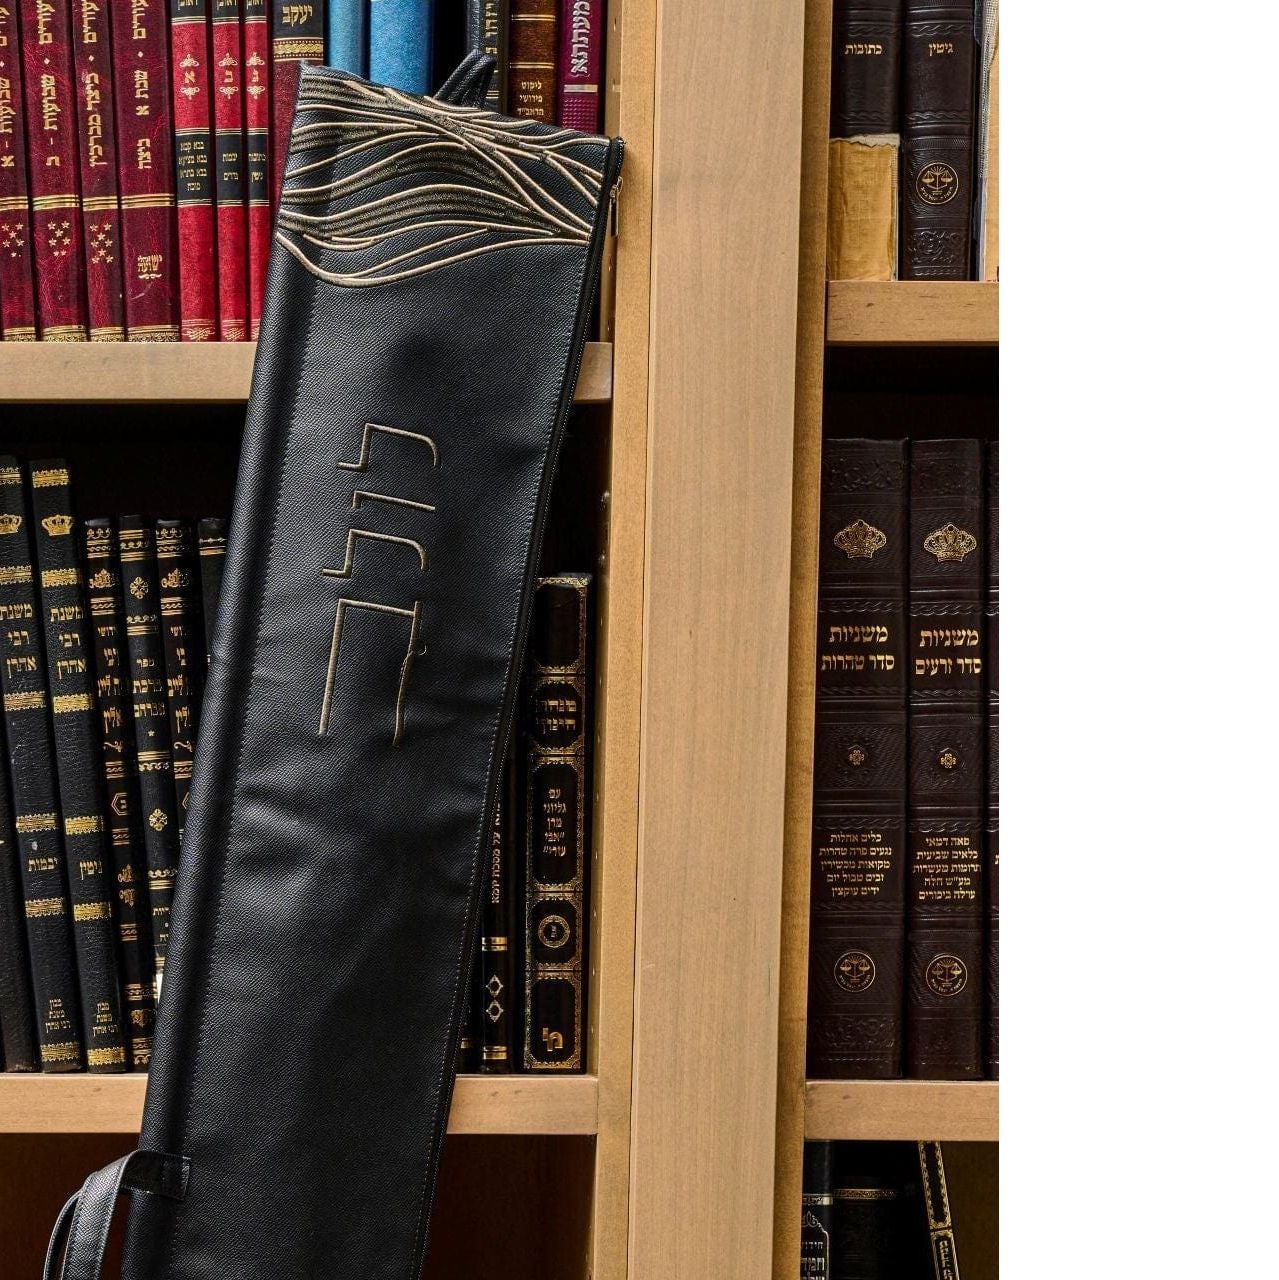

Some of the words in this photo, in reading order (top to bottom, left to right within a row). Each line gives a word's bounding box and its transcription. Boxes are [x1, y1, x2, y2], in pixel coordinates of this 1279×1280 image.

[282, 5, 312, 26] יעקב
[844, 43, 883, 55] כתובות
[928, 42, 954, 56] גיטין
[134, 70, 148, 98] שבת
[136, 106, 150, 116] א
[0, 604, 32, 620] משנת
[8, 630, 30, 646] רבי
[829, 626, 888, 642] משניות
[920, 629, 979, 647] משניות
[6, 656, 37, 678] אהרן
[821, 654, 864, 671] טהרות
[870, 655, 895, 670] סדר
[916, 658, 952, 676] זרעים
[956, 658, 982, 674] סדר
[861, 831, 882, 843] כלים
[925, 837, 946, 846] דמאי
[951, 837, 970, 846] פאה
